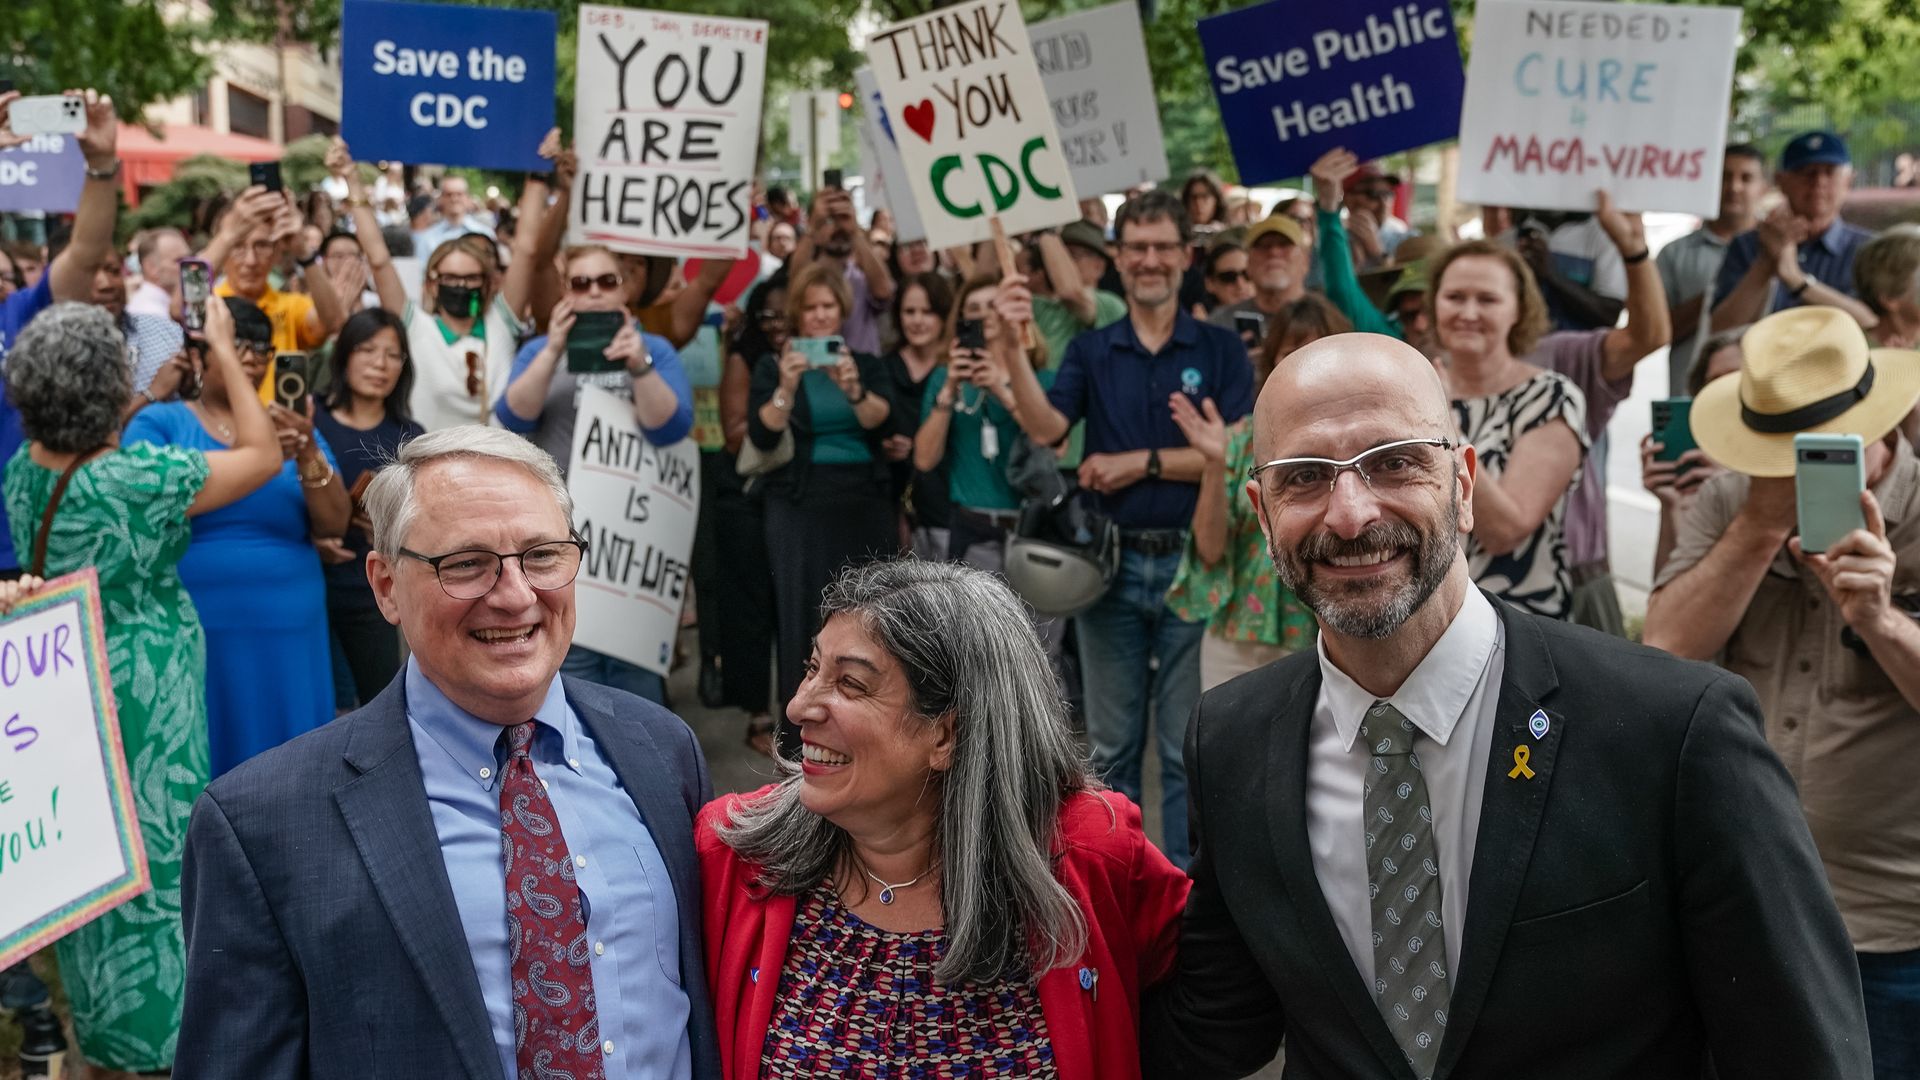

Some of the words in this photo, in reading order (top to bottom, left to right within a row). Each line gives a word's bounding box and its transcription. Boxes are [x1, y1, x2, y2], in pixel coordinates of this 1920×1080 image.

[871, 3, 1018, 80] THANK
[1214, 55, 1310, 94] Save
[1312, 3, 1448, 70] Public
[1526, 9, 1690, 42] NEEDED:
[372, 39, 460, 79] Save
[466, 45, 527, 83] the
[598, 32, 744, 111] YOU
[1513, 52, 1658, 103] CURE
[410, 91, 489, 130] CDC
[932, 73, 1021, 139] YOU
[1271, 73, 1415, 142] Health
[600, 117, 723, 164] ARE
[1483, 133, 1706, 180] MAGA-VIRUS
[580, 172, 748, 241] HEROES
[930, 136, 1063, 218] CDC
[582, 415, 694, 500] ANTI-VAX
[624, 486, 651, 523] IS
[578, 518, 688, 600] ANTI-LIFE
